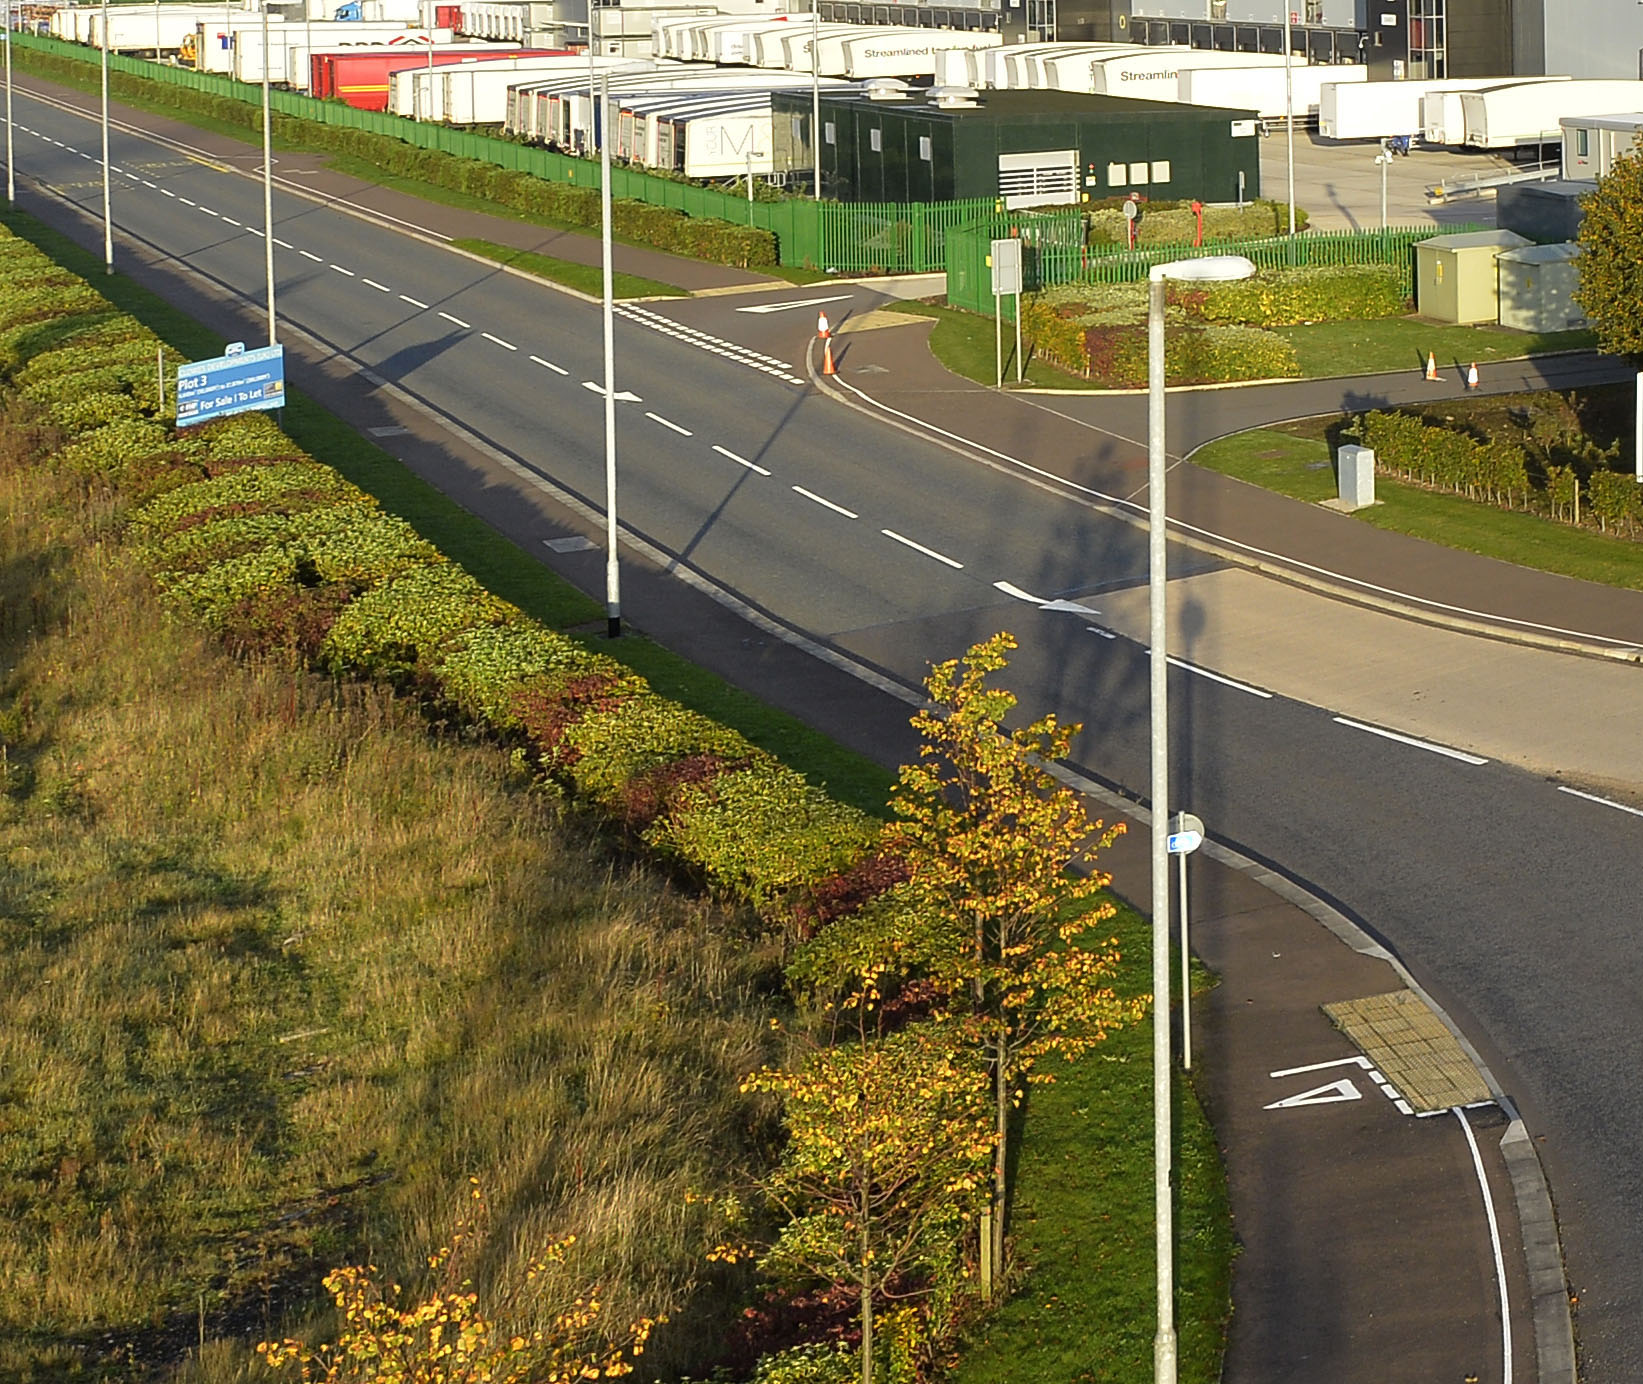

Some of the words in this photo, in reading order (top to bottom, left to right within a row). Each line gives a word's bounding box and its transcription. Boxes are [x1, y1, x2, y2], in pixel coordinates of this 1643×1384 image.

[864, 47, 929, 58] Streamlined
[1120, 69, 1179, 82] Streamlin
[178, 378, 199, 391] Plot
[200, 375, 208, 386] 3
[200, 400, 215, 411] For
[215, 396, 233, 407] Sale
[239, 392, 249, 401] To
[249, 389, 263, 398] Let
